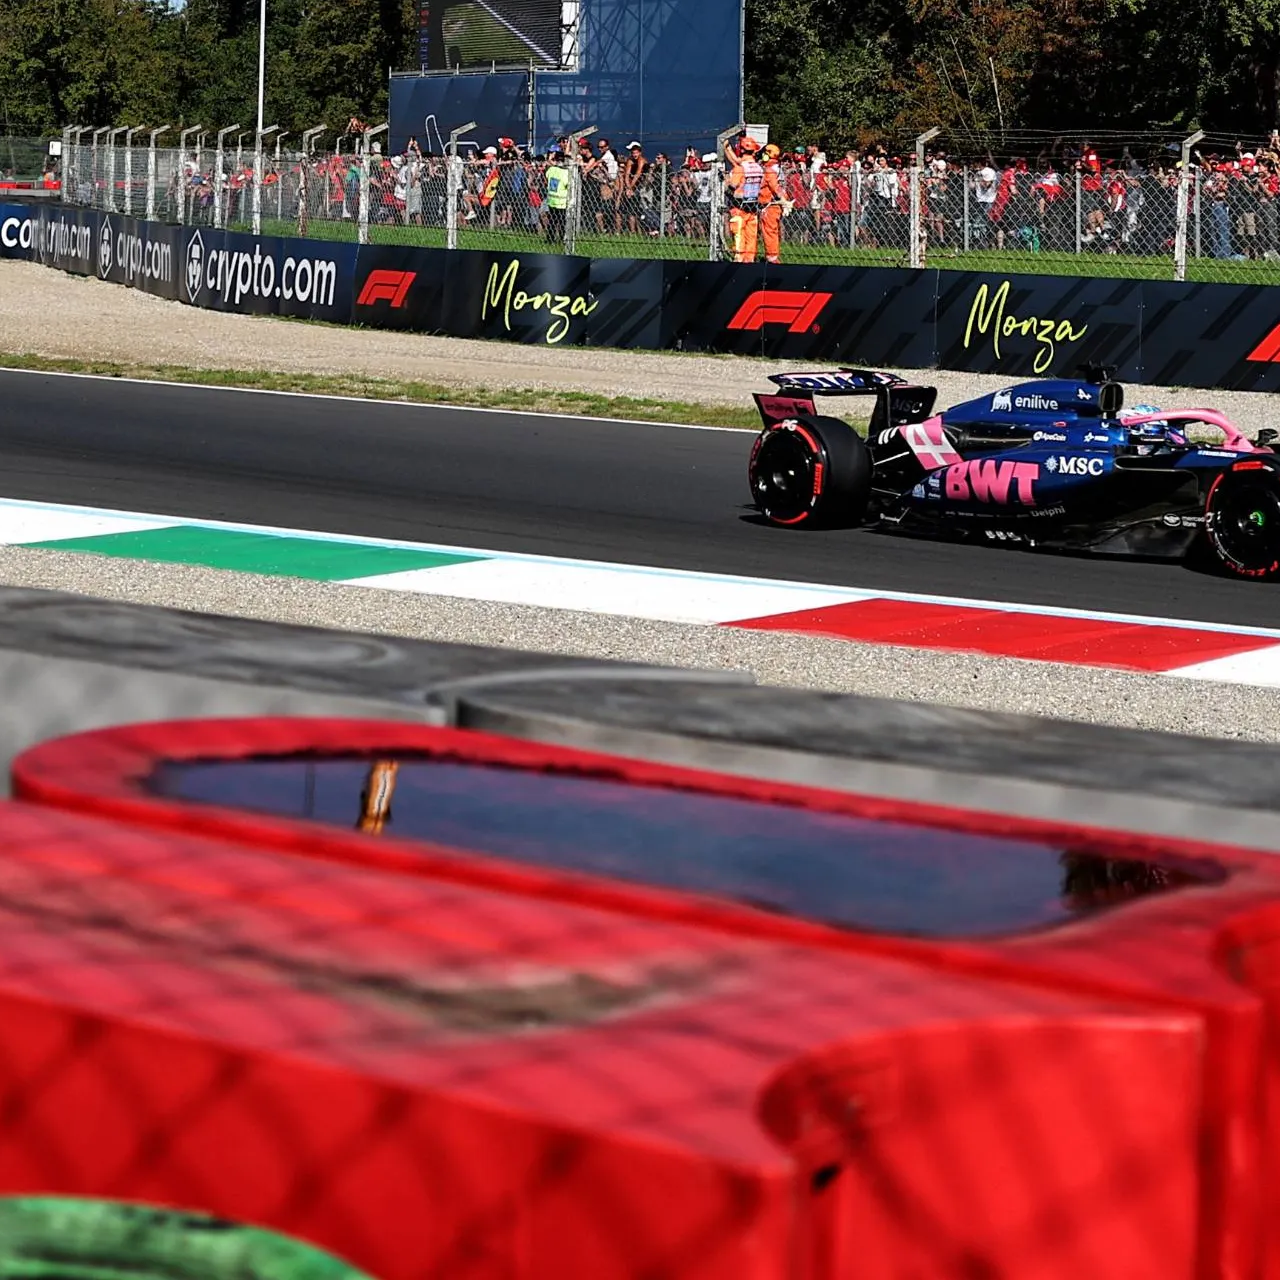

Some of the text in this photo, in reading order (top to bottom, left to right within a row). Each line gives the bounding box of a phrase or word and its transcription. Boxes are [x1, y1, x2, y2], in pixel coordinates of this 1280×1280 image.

[206, 244, 336, 306] crypto.com
[482, 258, 597, 345] Monza
[964, 280, 1086, 374] Monza
[1015, 394, 1059, 410] enilive
[945, 458, 1039, 506] BWT
[1059, 456, 1104, 476] MSC
